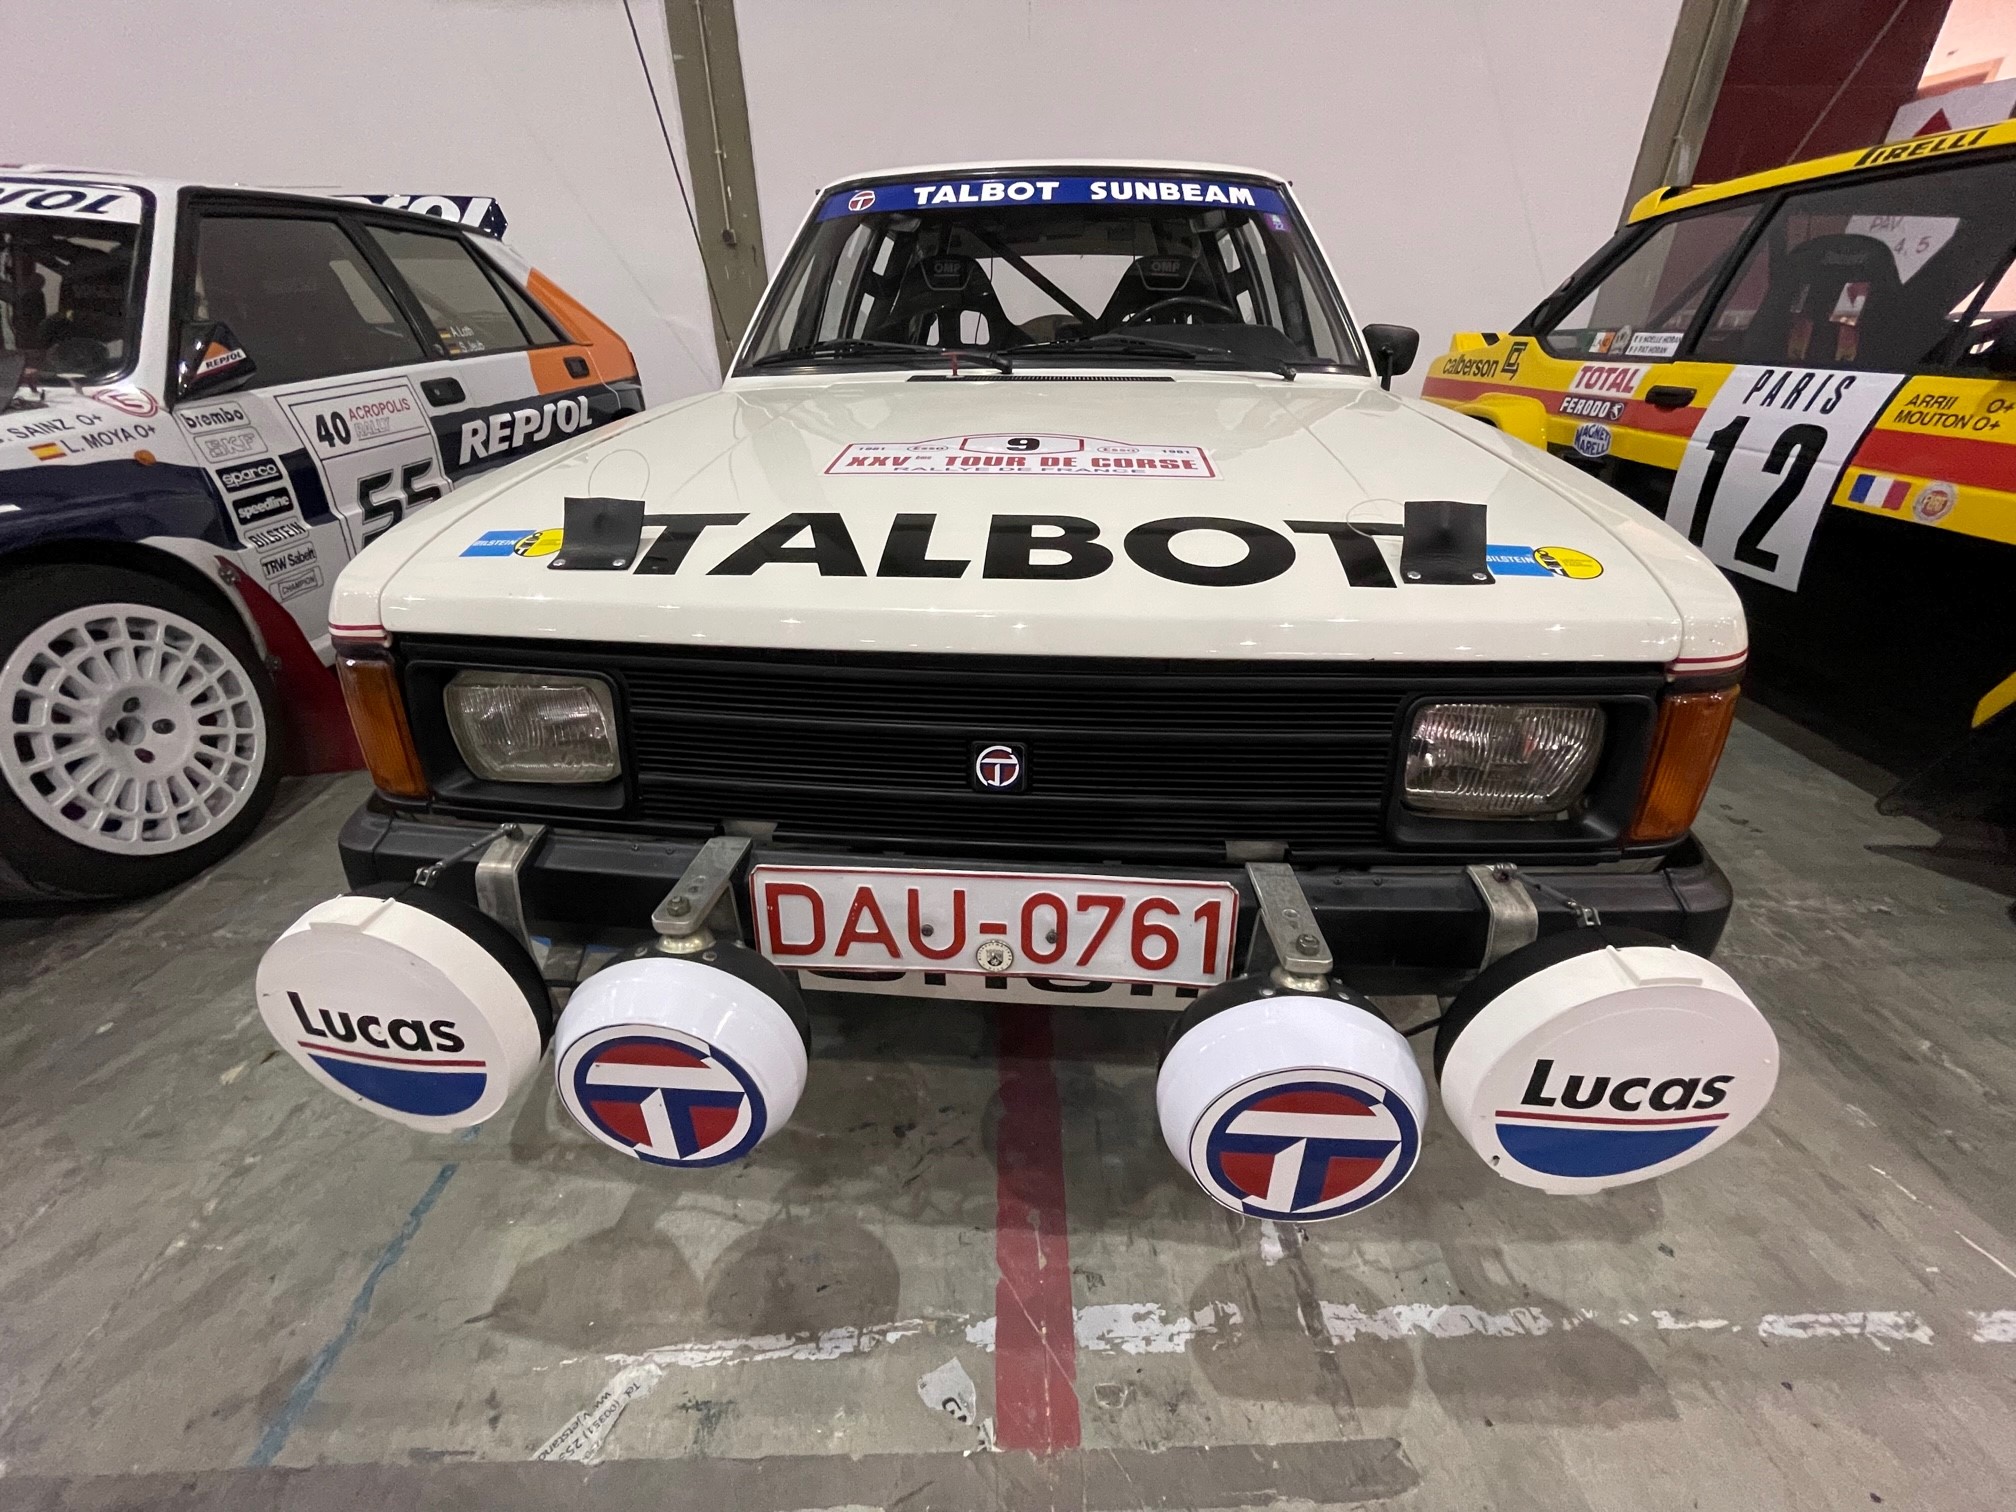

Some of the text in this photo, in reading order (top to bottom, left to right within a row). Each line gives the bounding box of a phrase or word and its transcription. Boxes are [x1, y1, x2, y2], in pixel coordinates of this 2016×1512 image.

[913, 181, 1255, 206] TALBOT SUNBEAM
[933, 263, 961, 273] OMP
[1152, 262, 1180, 273] OMP
[205, 351, 243, 369] REPSOL
[1442, 354, 1499, 377] calberson
[1575, 365, 1641, 393] TOTAL
[1743, 369, 1856, 415] PARIS
[1904, 394, 1959, 410] ARRII
[180, 408, 244, 428] brembo
[348, 398, 411, 422] ACROPOLIS
[1559, 397, 1611, 418] FERODO
[6, 418, 76, 439] SAINZ
[315, 411, 351, 448] 40
[354, 416, 391, 437] RALLY
[459, 395, 593, 466] REPSOL
[1894, 410, 1974, 430] MOUTON
[60, 439, 86, 453] L.
[81, 428, 134, 449] MOYA
[204, 433, 255, 458] SKF
[1007, 437, 1041, 452] 9
[222, 464, 277, 486] sparco
[846, 456, 911, 466] XXV
[945, 456, 1026, 467] TOUR
[1040, 457, 1078, 467] DE
[1091, 457, 1198, 470] CORSE
[357, 458, 442, 548] 55
[1688, 416, 1828, 573] 12
[238, 495, 290, 519] speedline
[248, 522, 307, 548] BILSTEIN
[632, 511, 1404, 589] TALBOT
[262, 556, 287, 576] TRW
[281, 575, 316, 595] CHAMPION
[764, 882, 1223, 975] DAU-0761
[286, 990, 466, 1053] Lucas
[1520, 1058, 1736, 1112] Lucas
